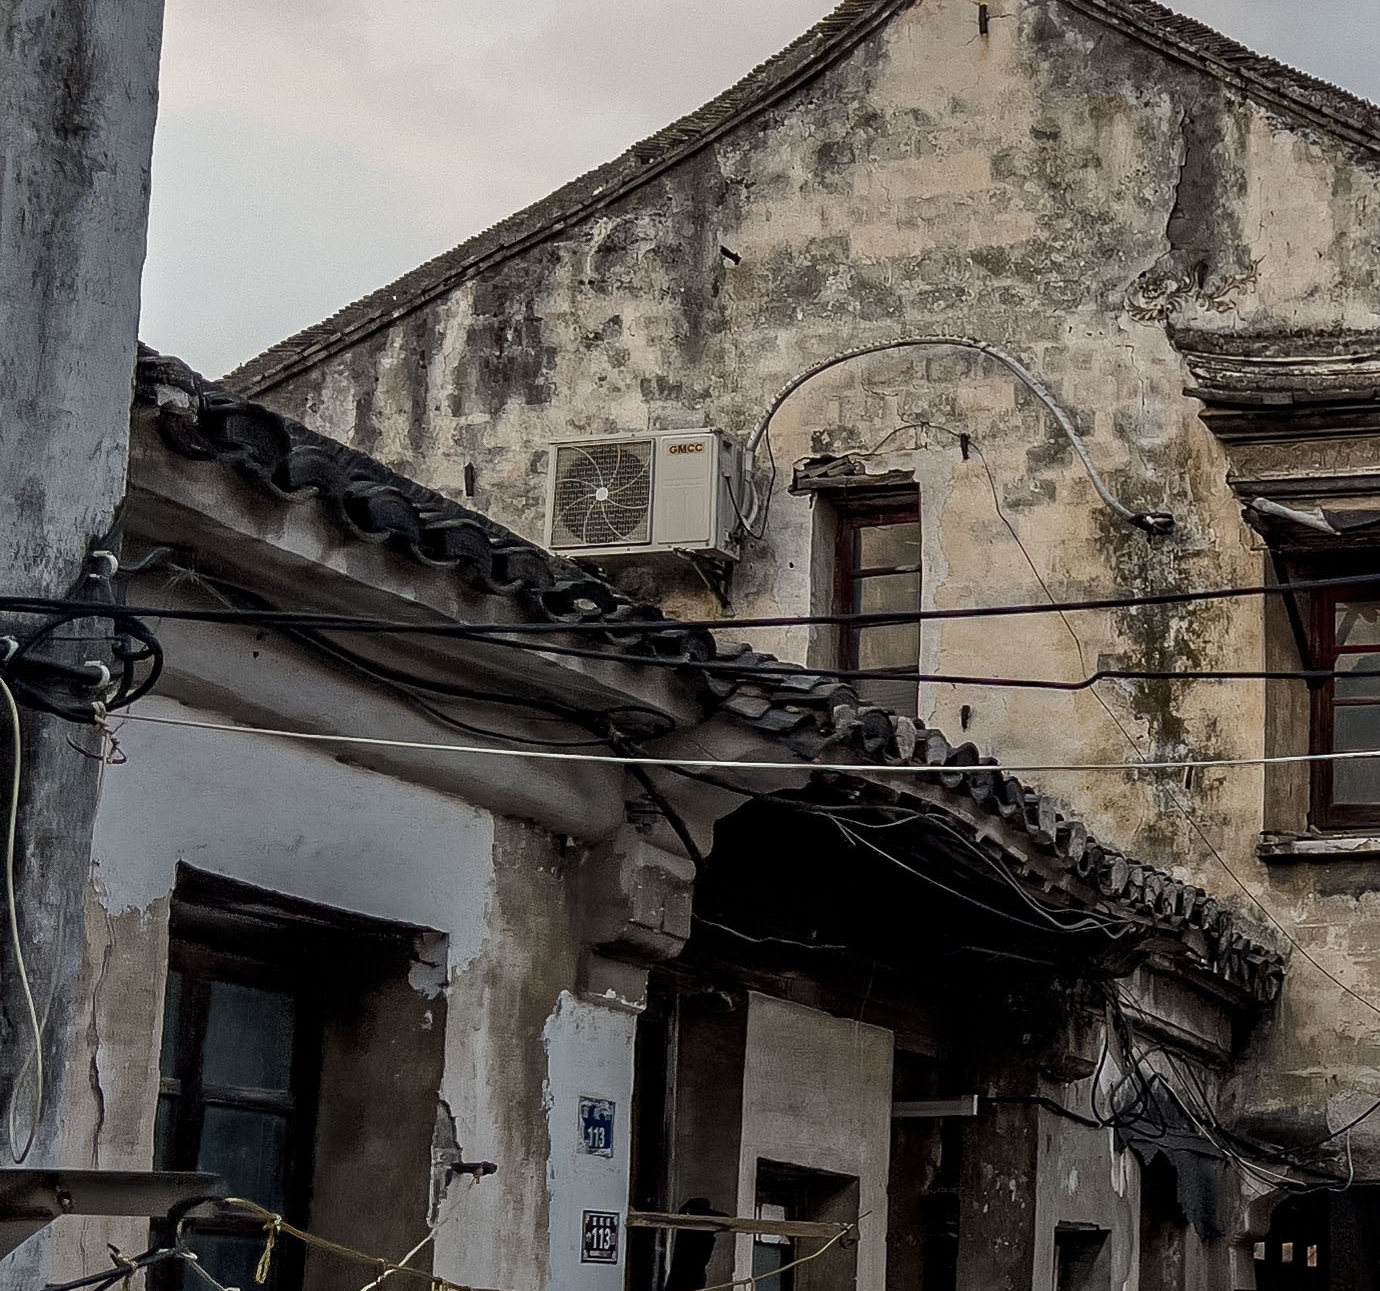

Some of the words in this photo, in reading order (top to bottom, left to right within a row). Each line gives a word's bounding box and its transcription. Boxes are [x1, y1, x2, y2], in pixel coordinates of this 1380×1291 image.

[669, 443, 703, 455] GMCC
[587, 1126, 606, 1148] 113
[591, 1227, 611, 1250] 113
